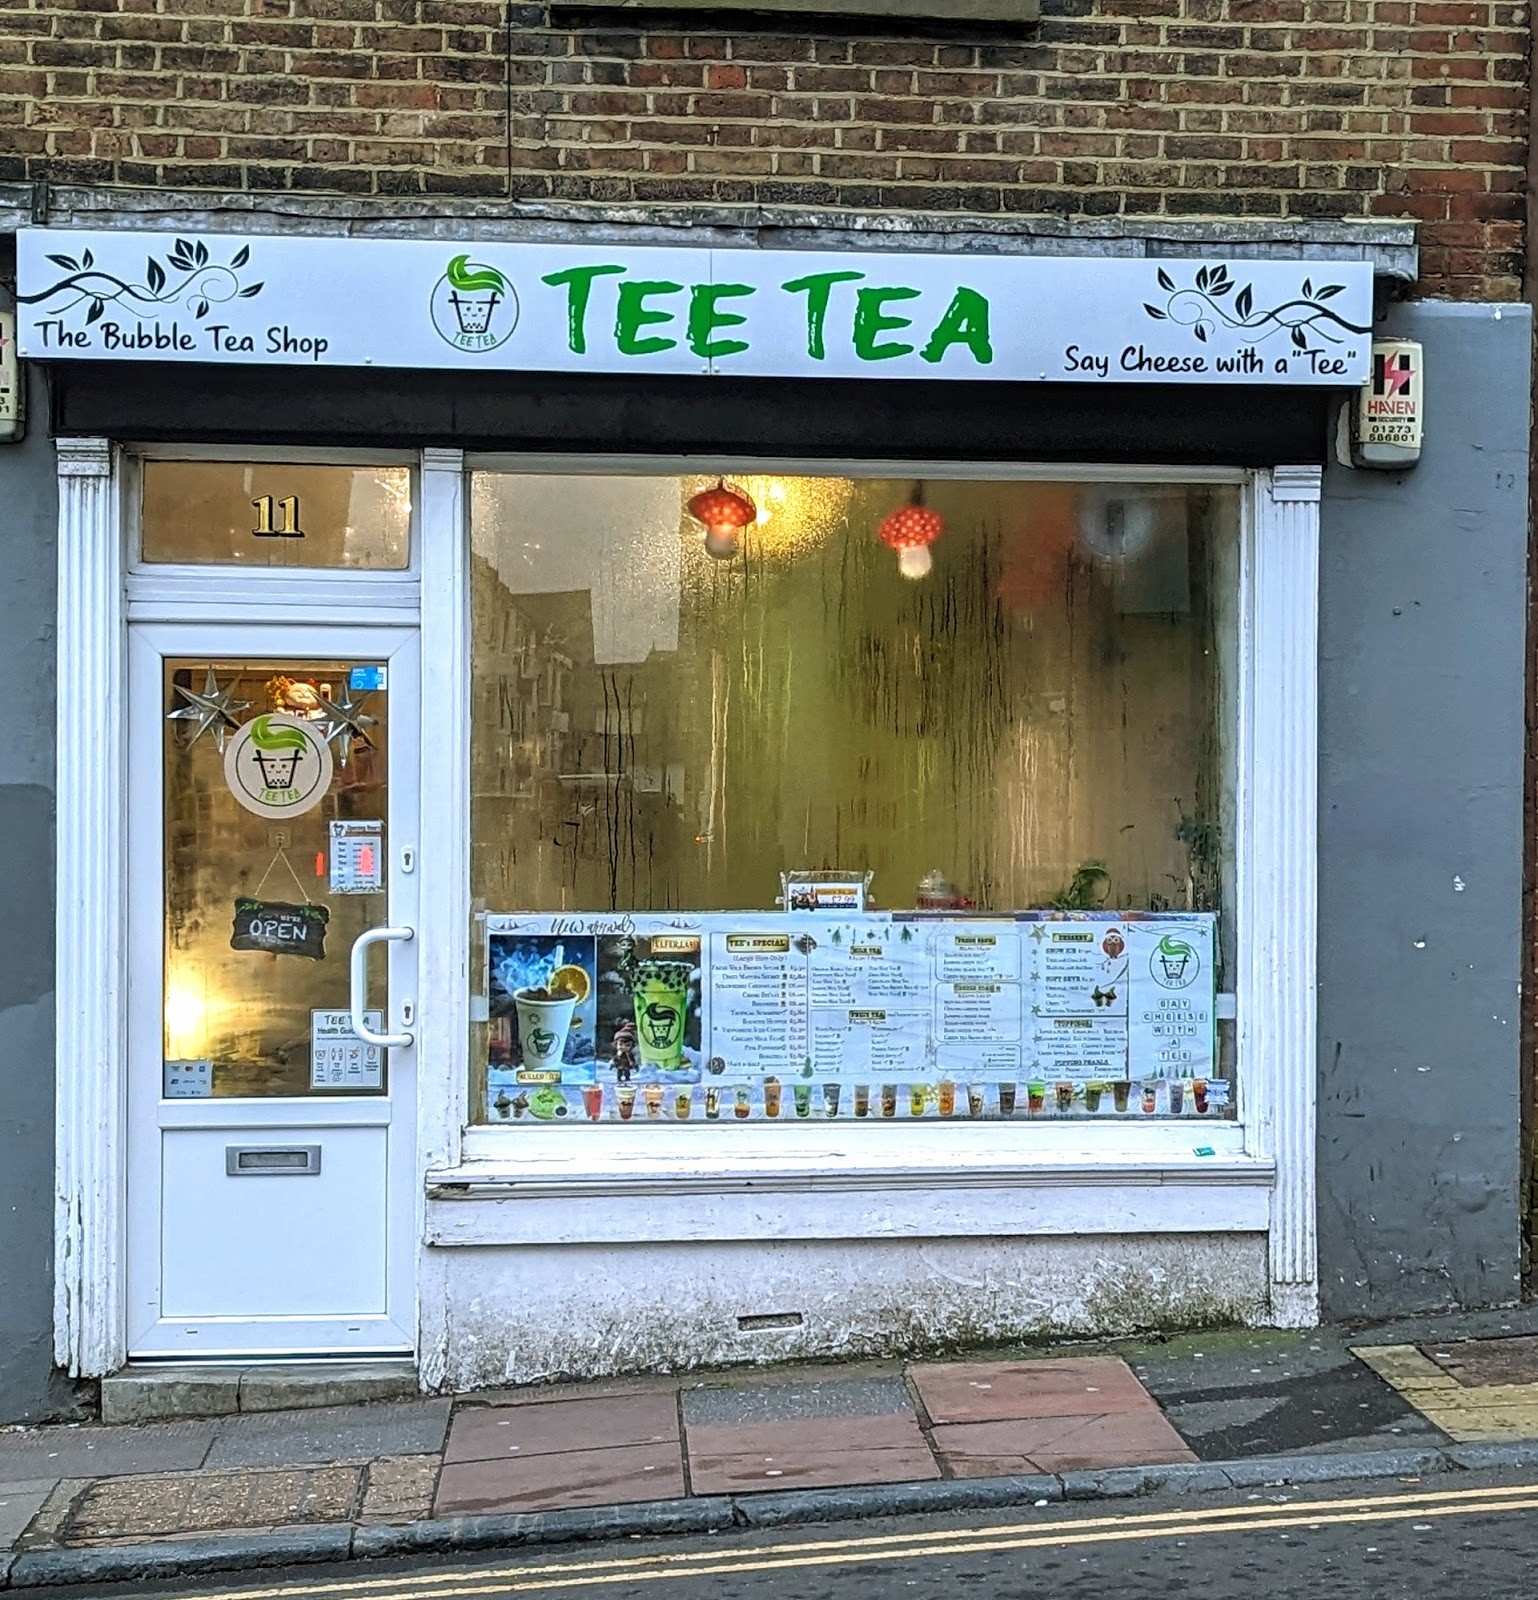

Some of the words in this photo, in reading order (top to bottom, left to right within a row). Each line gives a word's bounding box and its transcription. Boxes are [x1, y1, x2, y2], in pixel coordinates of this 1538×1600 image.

[541, 265, 755, 359] TEE
[782, 271, 993, 364] TEA
[33, 320, 91, 348] The
[99, 321, 196, 351] Bubble
[204, 325, 254, 353] Tea
[266, 326, 328, 363] Shop
[1064, 345, 1109, 378] Say
[1120, 345, 1209, 373] Cheese
[1216, 347, 1264, 374] with
[1274, 358, 1288, 374] a
[1367, 401, 1416, 415] HAVEN
[1371, 425, 1412, 434] 01273
[252, 495, 305, 538] 11
[249, 919, 307, 941] OPEN
[752, 939, 786, 948] SPECIAL
[324, 1015, 346, 1025] TEE
[1154, 1026, 1194, 1034] WITH
